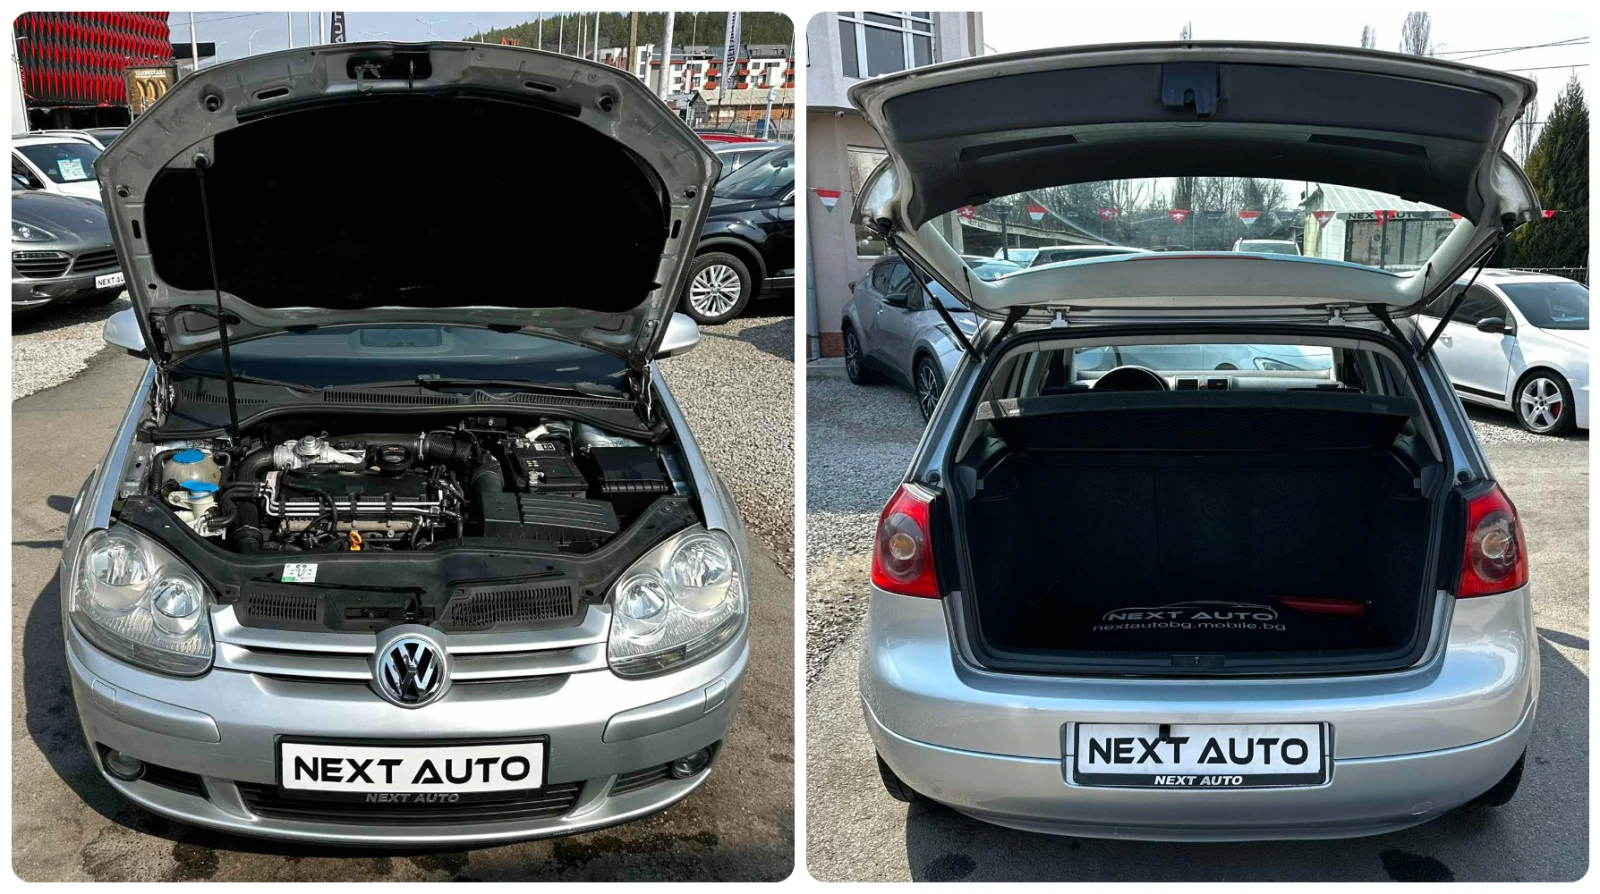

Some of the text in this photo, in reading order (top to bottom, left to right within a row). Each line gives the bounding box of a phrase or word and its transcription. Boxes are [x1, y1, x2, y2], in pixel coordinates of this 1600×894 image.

[1108, 611, 1274, 621] NEXT AUTO
[1092, 621, 1287, 632] nextautobg.mobile.bg
[1088, 736, 1309, 765] NEXT AUTO
[294, 755, 531, 784] NEXT AUTO
[1154, 775, 1243, 786] NEXT AUTO
[365, 793, 460, 803] NEXT AUTO
